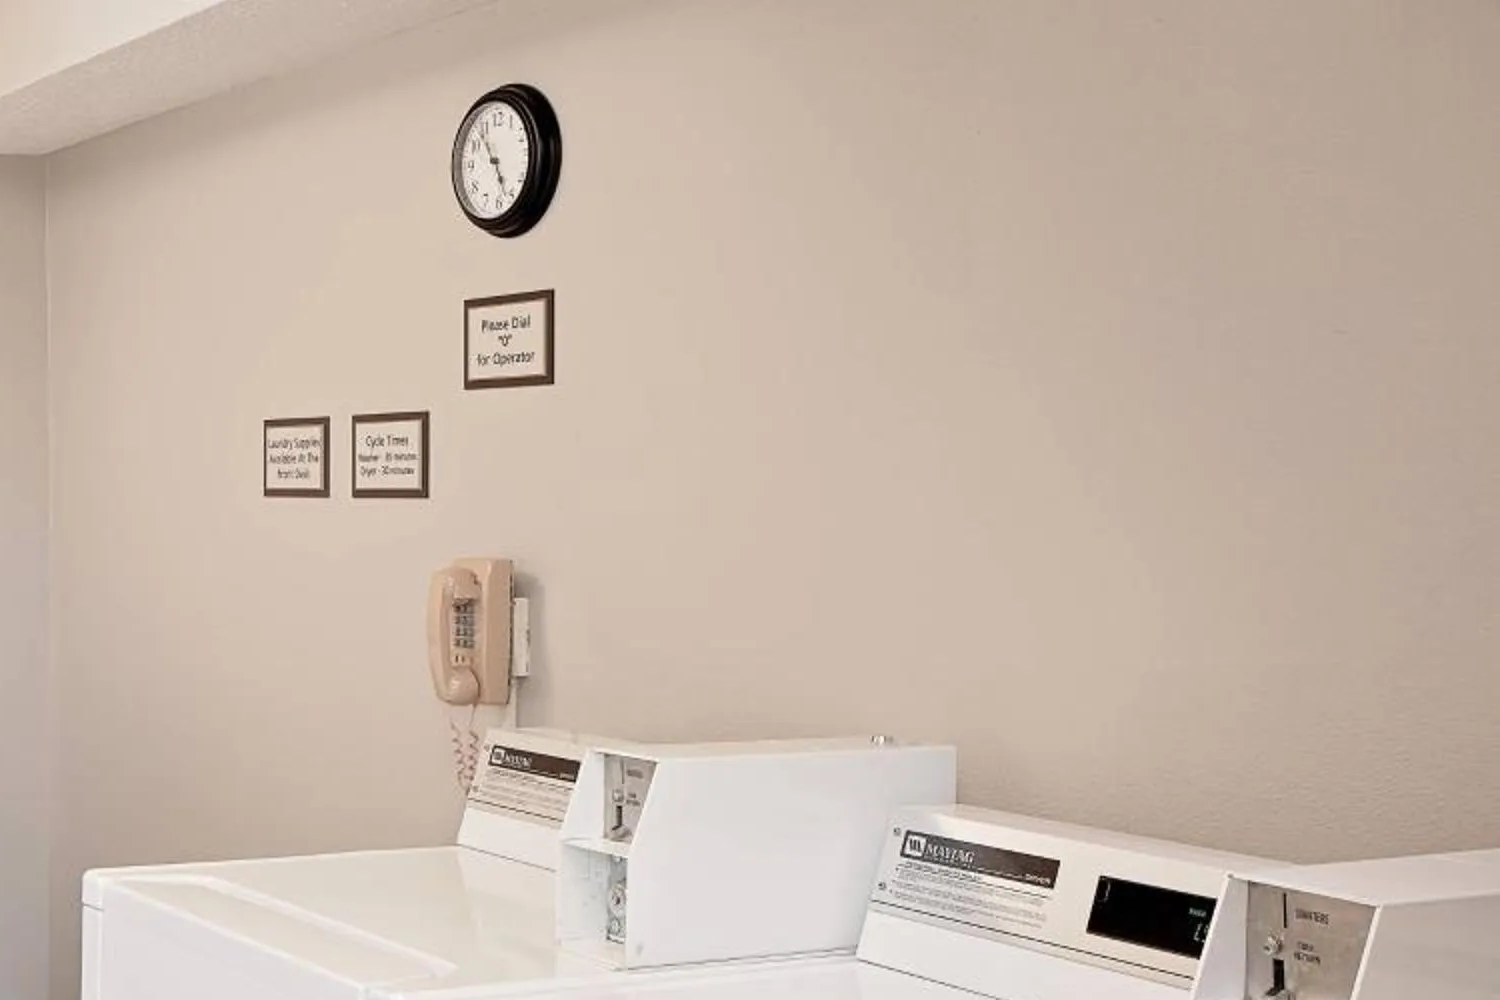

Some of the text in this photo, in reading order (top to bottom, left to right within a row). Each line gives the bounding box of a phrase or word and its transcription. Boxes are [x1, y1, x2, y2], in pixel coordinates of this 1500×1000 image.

[481, 314, 531, 333] Please Dial
[493, 351, 535, 367] Operator
[268, 437, 321, 450] Laundry Supplies
[365, 435, 409, 448] Cycle Times
[924, 842, 976, 864] MAYTAG
